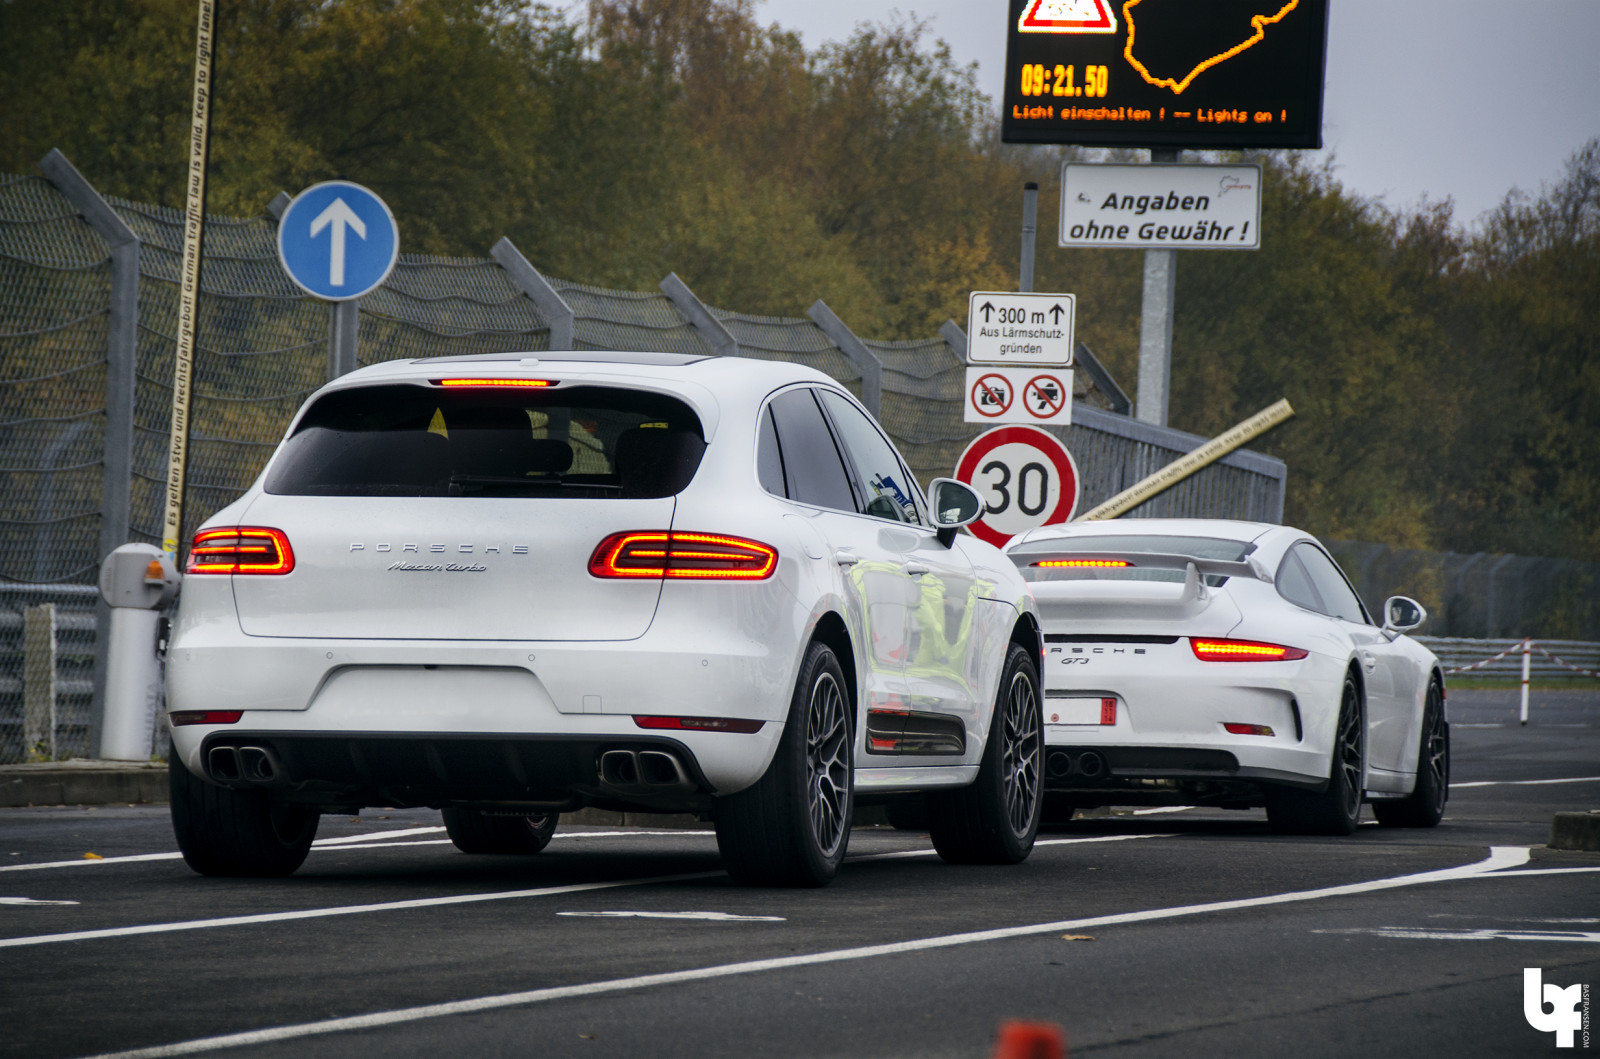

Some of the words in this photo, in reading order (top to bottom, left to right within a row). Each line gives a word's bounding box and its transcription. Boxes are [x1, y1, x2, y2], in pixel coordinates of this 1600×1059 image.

[200, 1, 211, 33] lane!
[199, 36, 211, 67] right
[197, 70, 206, 84] to
[1021, 63, 1109, 98] 09:21.50
[195, 88, 208, 119] Keep
[1012, 104, 1054, 119] Licht
[1060, 105, 1151, 121] einschalten
[1197, 108, 1248, 124] Lights
[1253, 110, 1273, 123] on
[192, 124, 204, 156] valid.
[191, 160, 201, 173] is
[189, 176, 200, 200] law
[1100, 190, 1210, 215] Angaben
[188, 201, 200, 240] traffic
[1070, 220, 1129, 240] ohne
[184, 244, 196, 293] German
[998, 308, 1026, 324] 300
[1031, 311, 1045, 324] m
[979, 326, 999, 338] Aus
[1002, 327, 1065, 339] Lärmschutz-
[177, 296, 193, 405] Rechtsfahrgebot!
[1000, 342, 1042, 356] gründen
[175, 408, 185, 432] und
[169, 470, 180, 508] gelten
[981, 460, 1049, 517] 30
[167, 512, 176, 527] Es
[350, 542, 529, 555] PORSCHE
[387, 559, 444, 572] Macan
[1050, 647, 1146, 655] RSCHE
[1061, 657, 1090, 665] GT3
